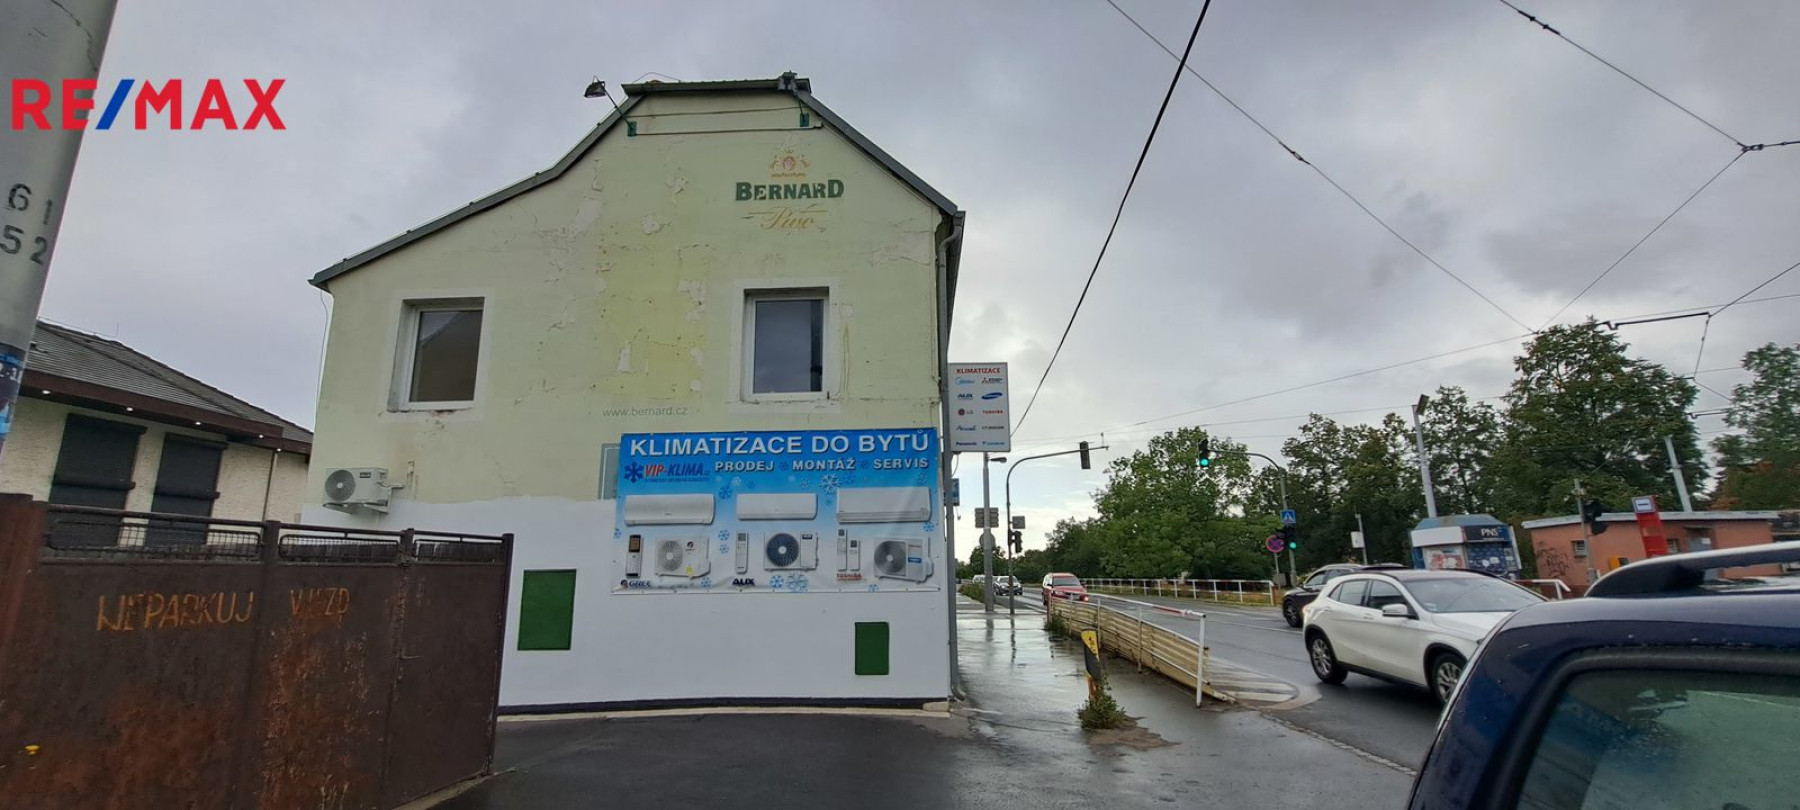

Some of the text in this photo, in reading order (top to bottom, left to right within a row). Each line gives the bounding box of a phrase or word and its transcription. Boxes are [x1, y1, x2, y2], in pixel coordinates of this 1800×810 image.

[736, 180, 844, 201] BERNARD
[602, 407, 689, 417] www.bernard.cz
[630, 429, 929, 456] KLIMATIZACE DO BYTŮ
[714, 457, 929, 472] PRODEJ MONTÁŽ SERVIS
[1481, 528, 1498, 536] PNS
[732, 578, 755, 586] AUX
[96, 591, 254, 631] NEPARKUJ
